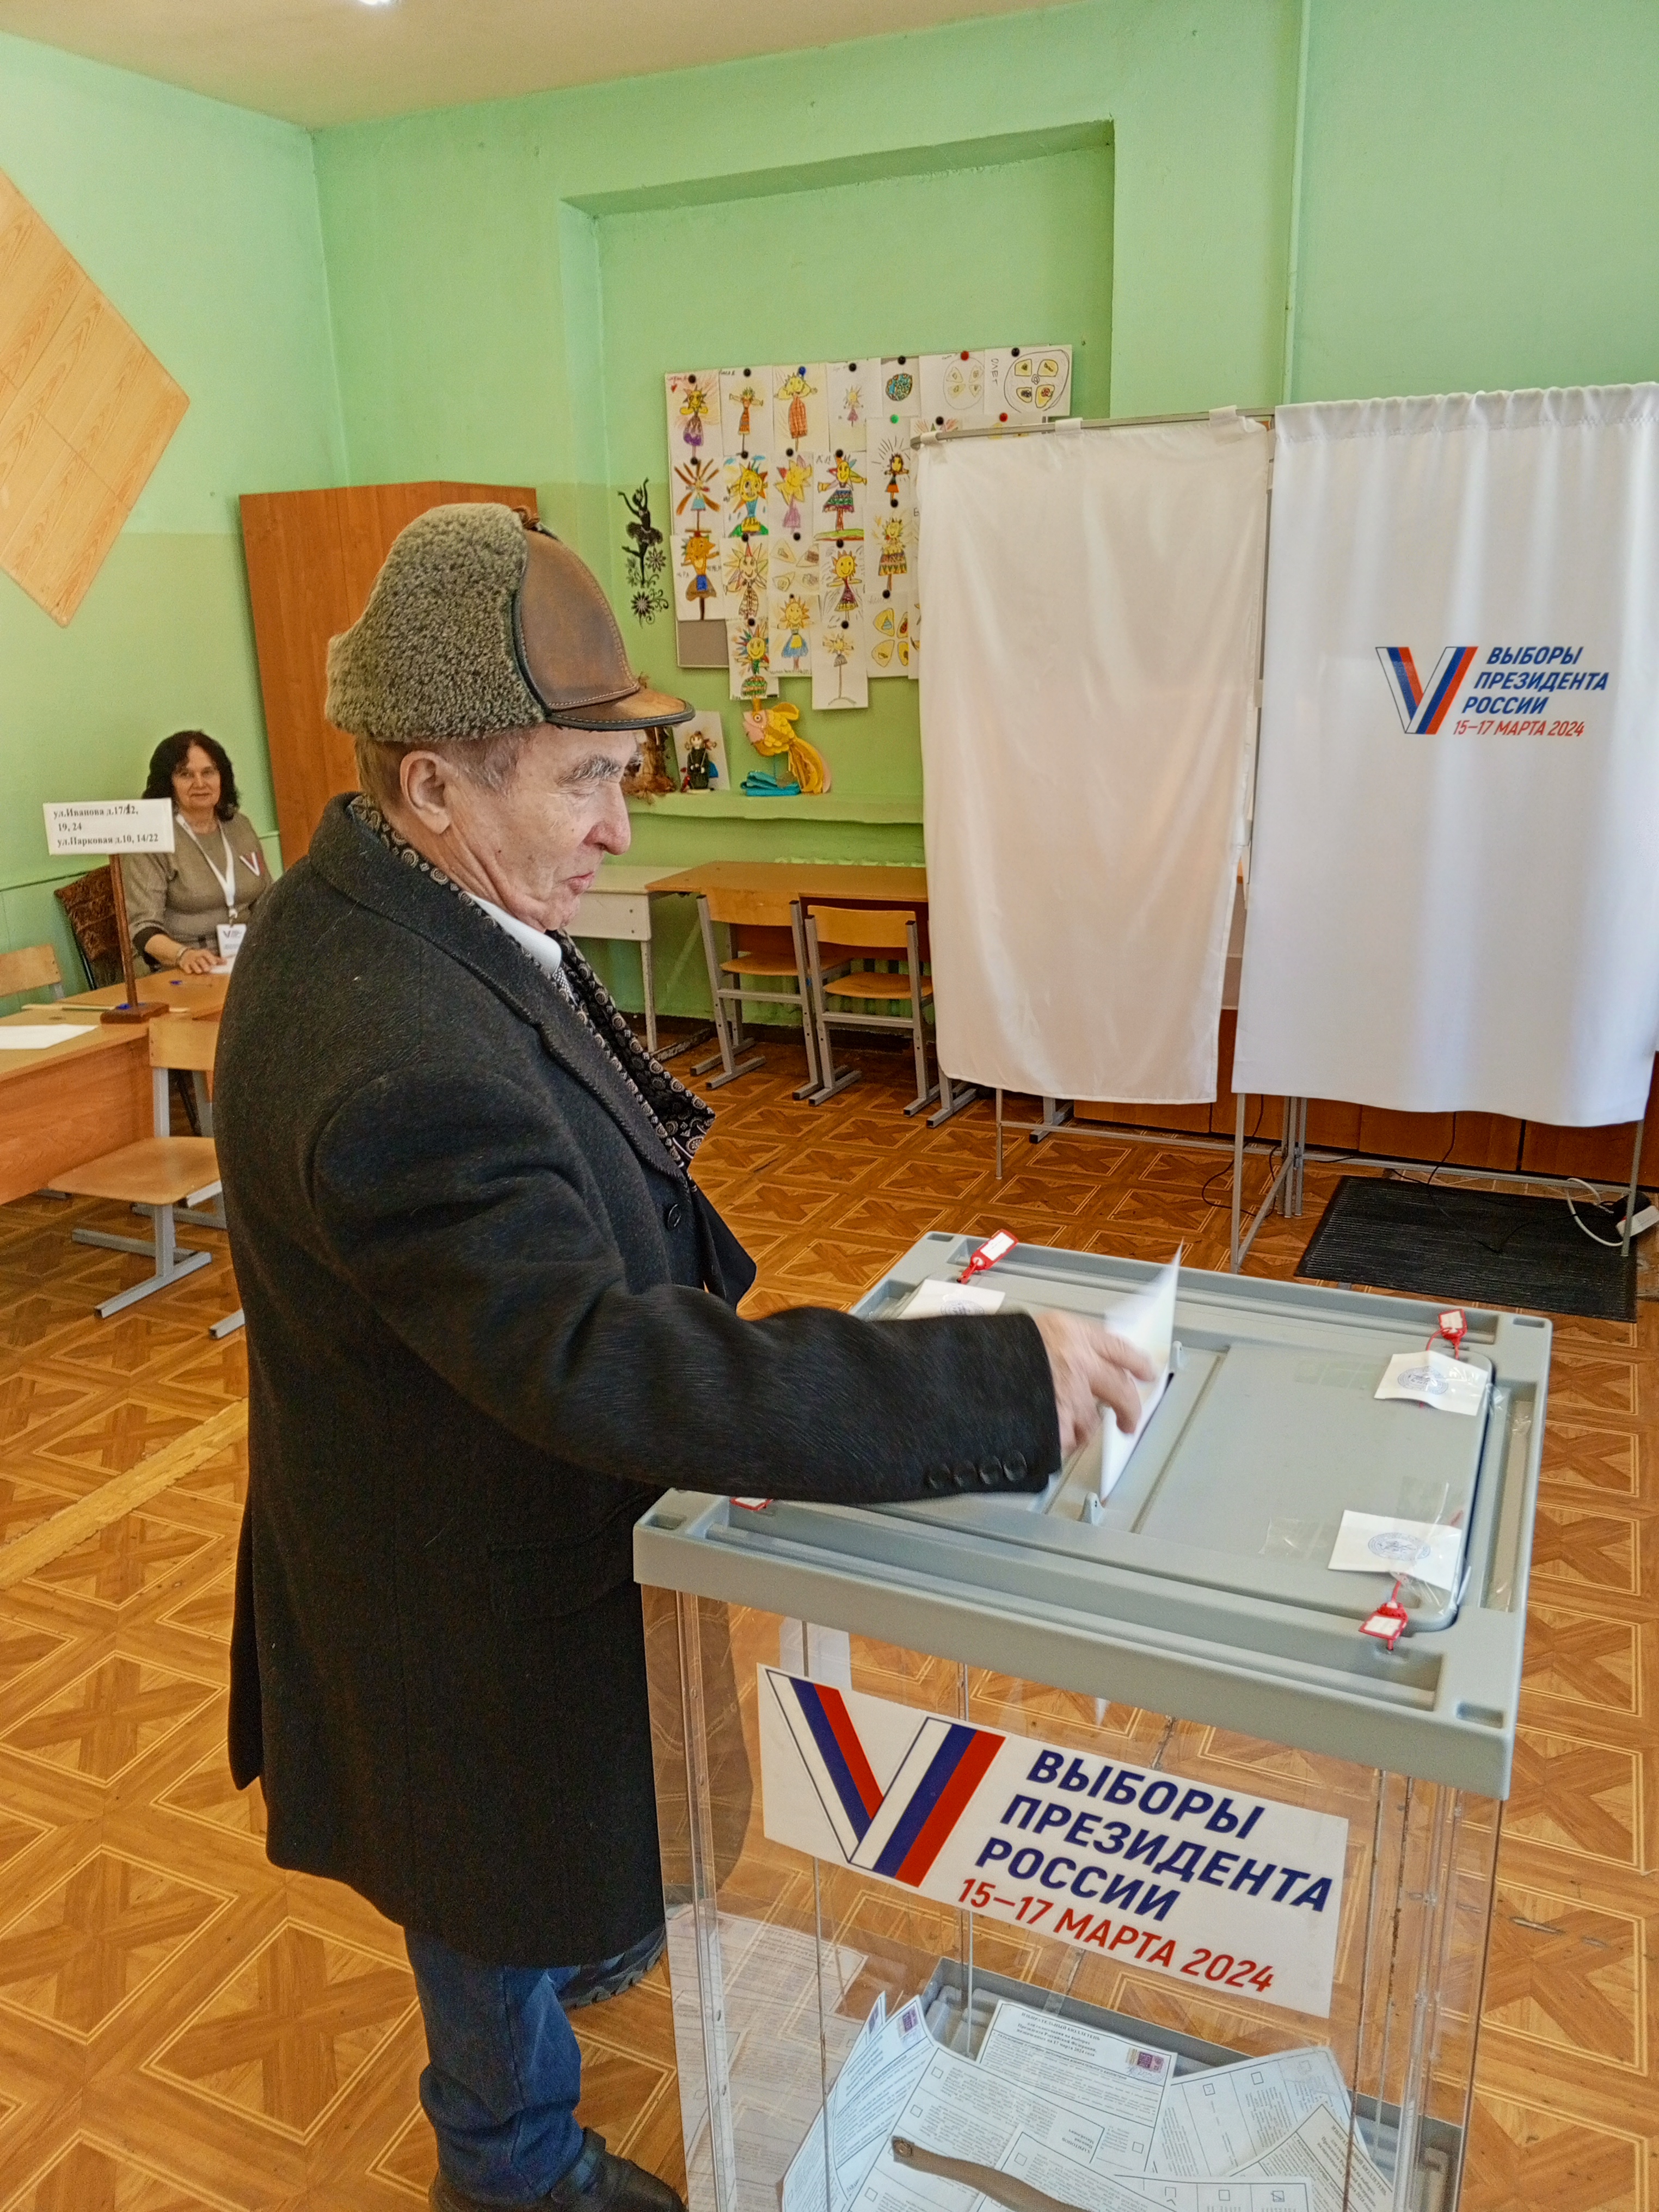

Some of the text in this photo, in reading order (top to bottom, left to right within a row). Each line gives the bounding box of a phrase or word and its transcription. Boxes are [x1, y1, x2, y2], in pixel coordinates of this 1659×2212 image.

[1486, 646, 1583, 665] ВЫБОРЫ
[1473, 672, 1609, 692] ПРЕЗИДЕНТА
[1462, 696, 1549, 714] РОССИИ
[1494, 721, 1546, 736] МАРТА
[1547, 721, 1585, 737] 2024
[58, 822, 82, 832] 19, 24
[137, 833, 158, 843] 14/22
[1028, 1749, 1265, 1839] ВЫБОРЫ
[1000, 1795, 1333, 1912] ПРЕЗИДЕНТА
[975, 1838, 1181, 1921] РОССИИ
[1053, 1907, 1177, 1968] МАРТА
[1180, 1947, 1274, 1993] 2024
